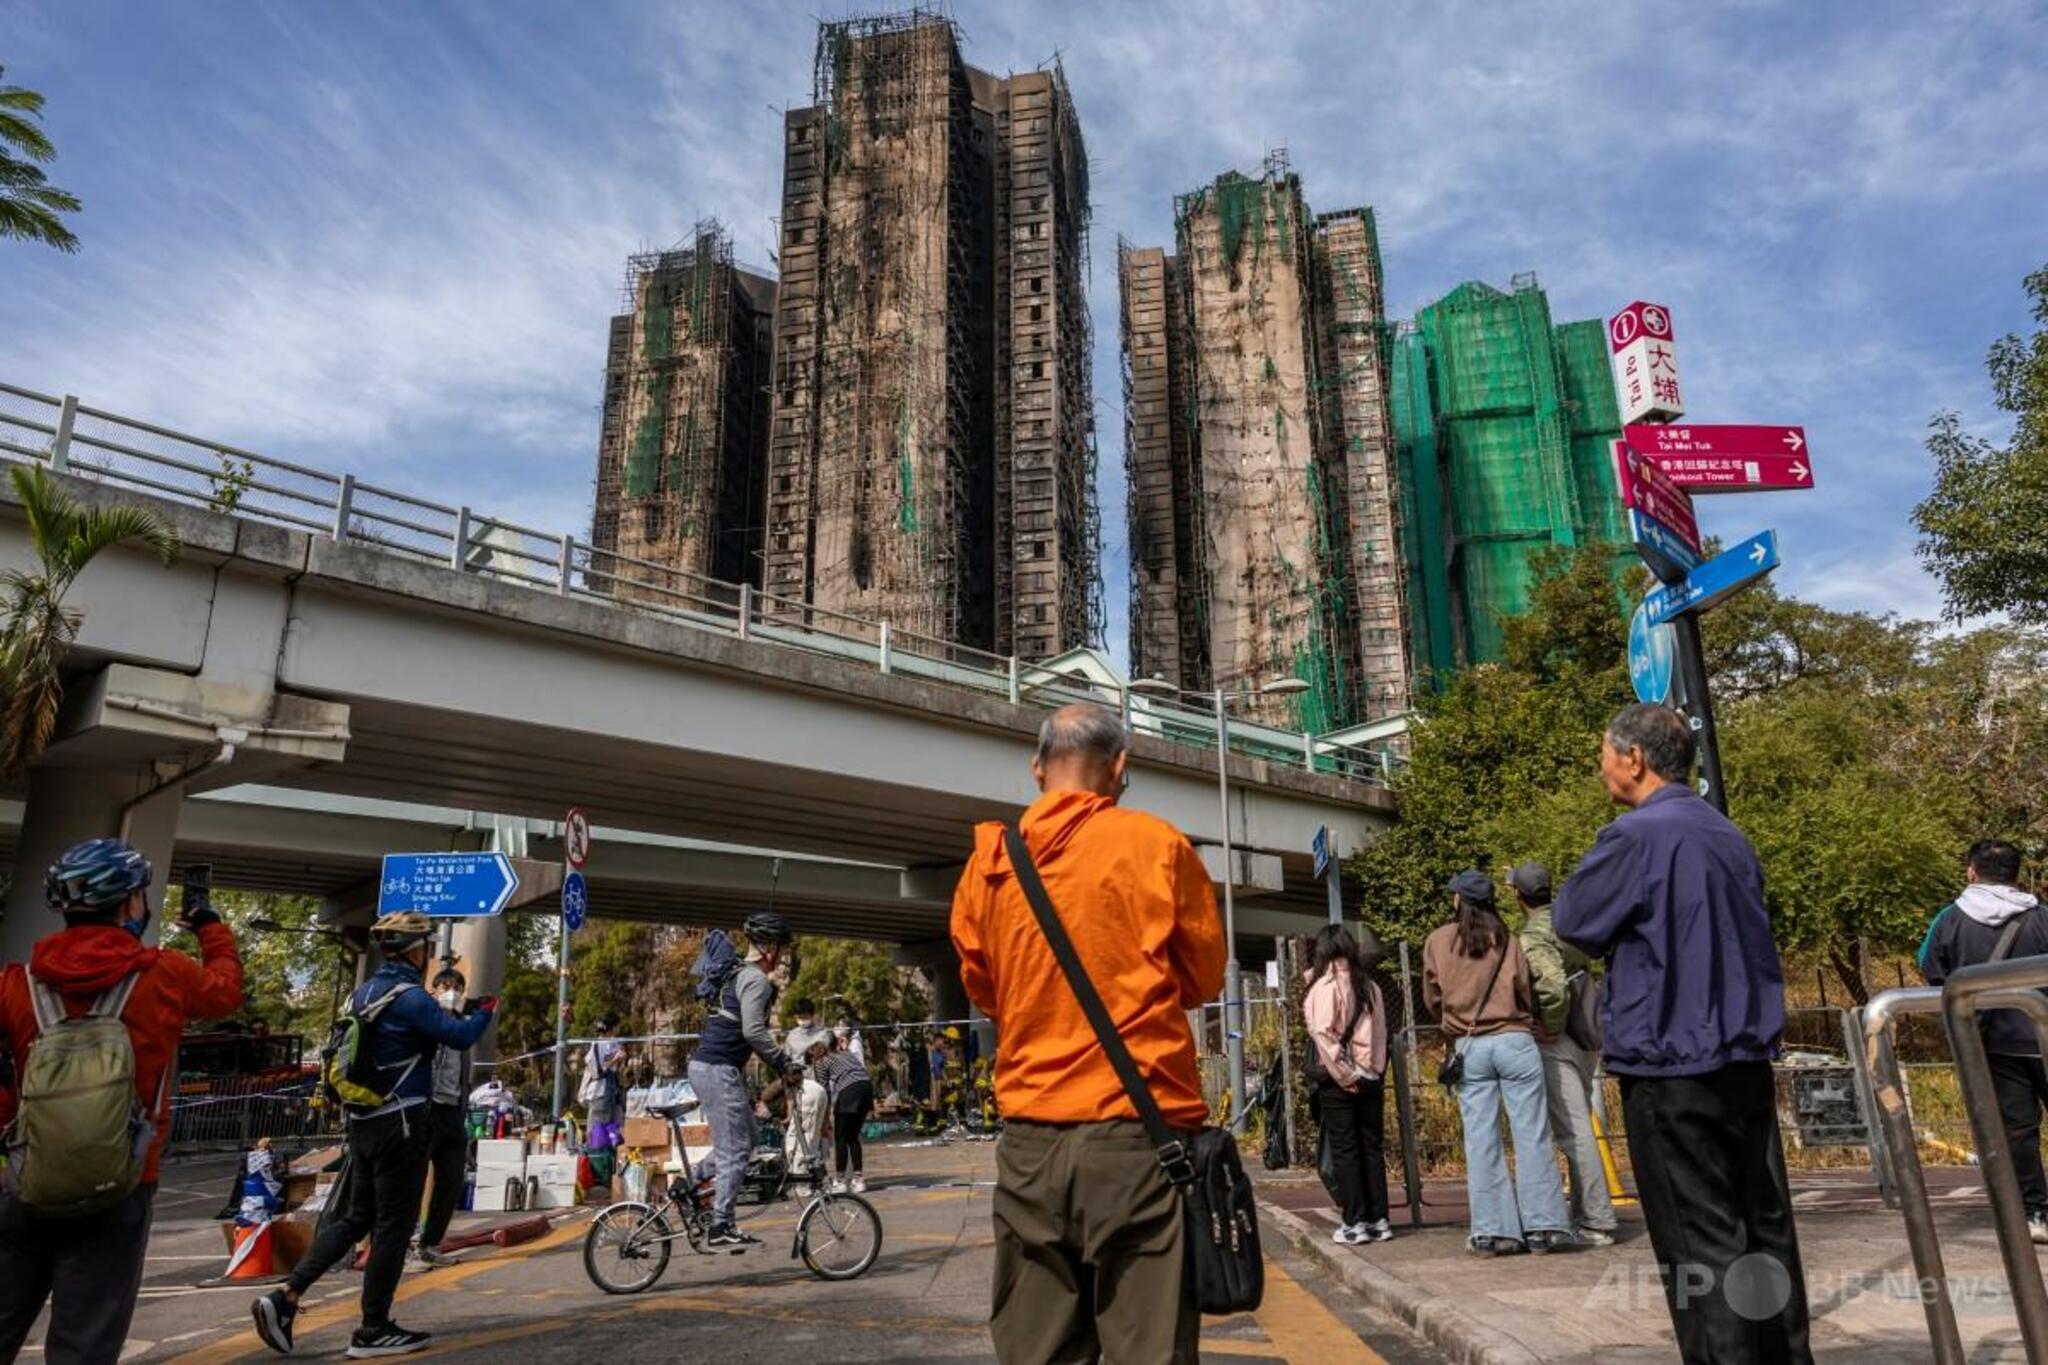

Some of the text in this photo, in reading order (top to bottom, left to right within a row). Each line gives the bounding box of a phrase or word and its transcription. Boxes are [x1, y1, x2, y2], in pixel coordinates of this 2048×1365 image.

[1648, 343, 1681, 404] 大埔
[1628, 380, 1642, 407] Tai
[1657, 442, 1712, 450] Tai Mei Tuk
[1668, 472, 1734, 481] ookout Tower
